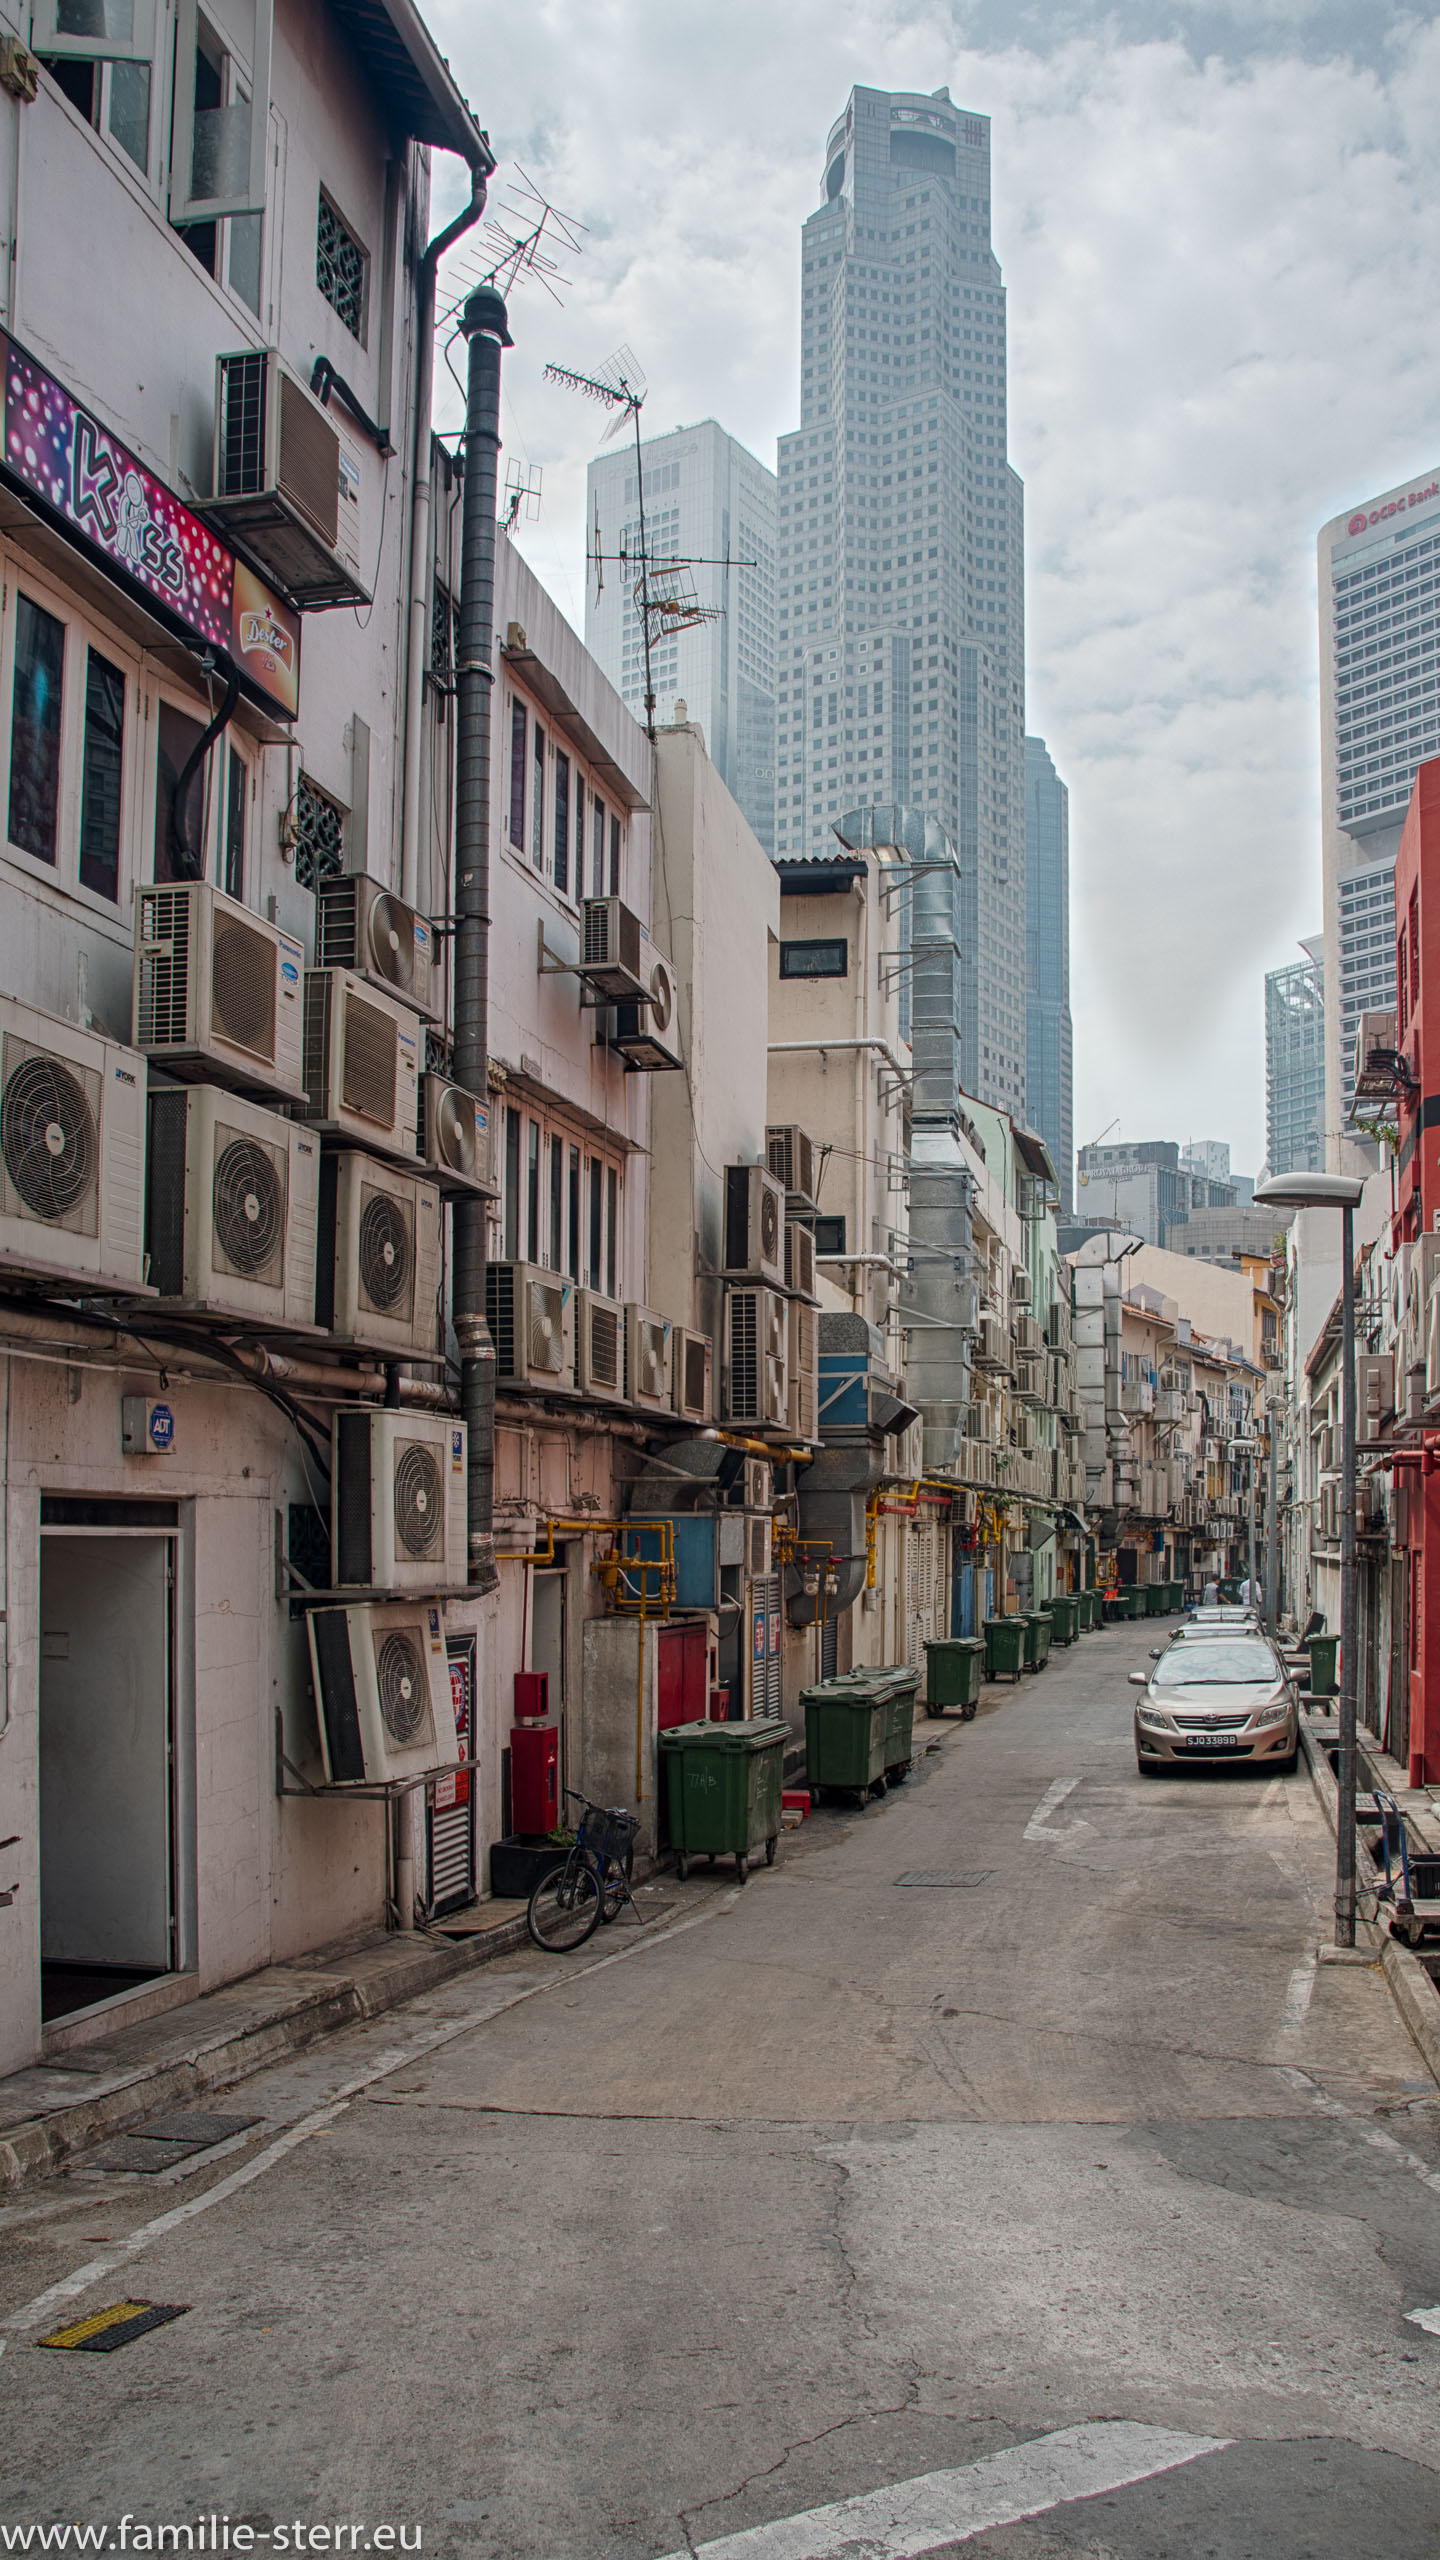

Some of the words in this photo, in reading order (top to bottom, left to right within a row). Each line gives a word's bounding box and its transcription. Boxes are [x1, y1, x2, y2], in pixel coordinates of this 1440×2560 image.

[1369, 498, 1405, 525] OCBC
[1408, 482, 1439, 507] Bank
[246, 619, 288, 650] Dester
[120, 1070, 136, 1085] YORK
[1092, 1167, 1119, 1177] ROYAL
[153, 1418, 171, 1433] ADT
